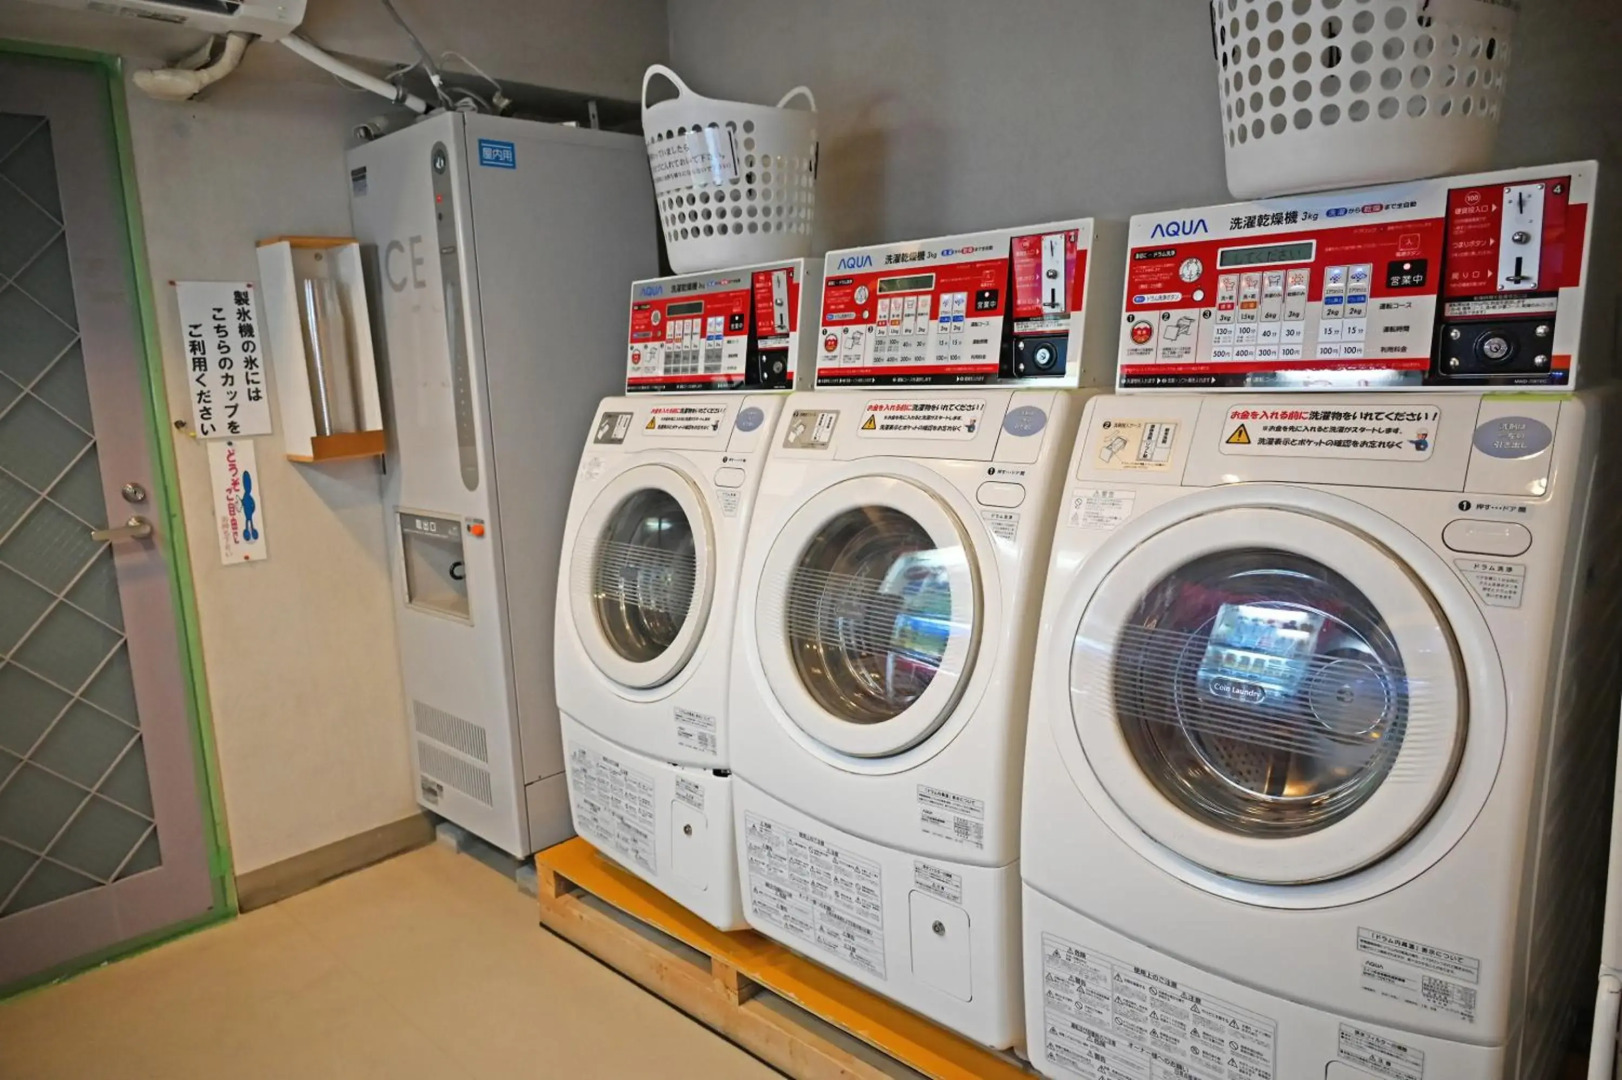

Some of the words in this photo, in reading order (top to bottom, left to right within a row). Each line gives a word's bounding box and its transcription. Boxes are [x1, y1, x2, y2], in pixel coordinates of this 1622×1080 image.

[482, 147, 513, 162] 屋内用
[1229, 210, 1298, 231] 洗濯乾燥機
[1301, 211, 1319, 222] 3kg
[1150, 218, 1209, 239] AQUA
[837, 255, 872, 270] AQUA
[884, 250, 925, 265] 洗濯乾燥機
[1390, 275, 1423, 287] 営業中
[639, 285, 663, 297] AQUA
[233, 290, 263, 402] 製氷機の氷には
[212, 307, 241, 434] こちらのカップを
[188, 323, 216, 436] ご利用ください
[1257, 437, 1404, 449] 洗濯表示とポケットの確認をお忘れなく
[1213, 683, 1231, 692] Coin
